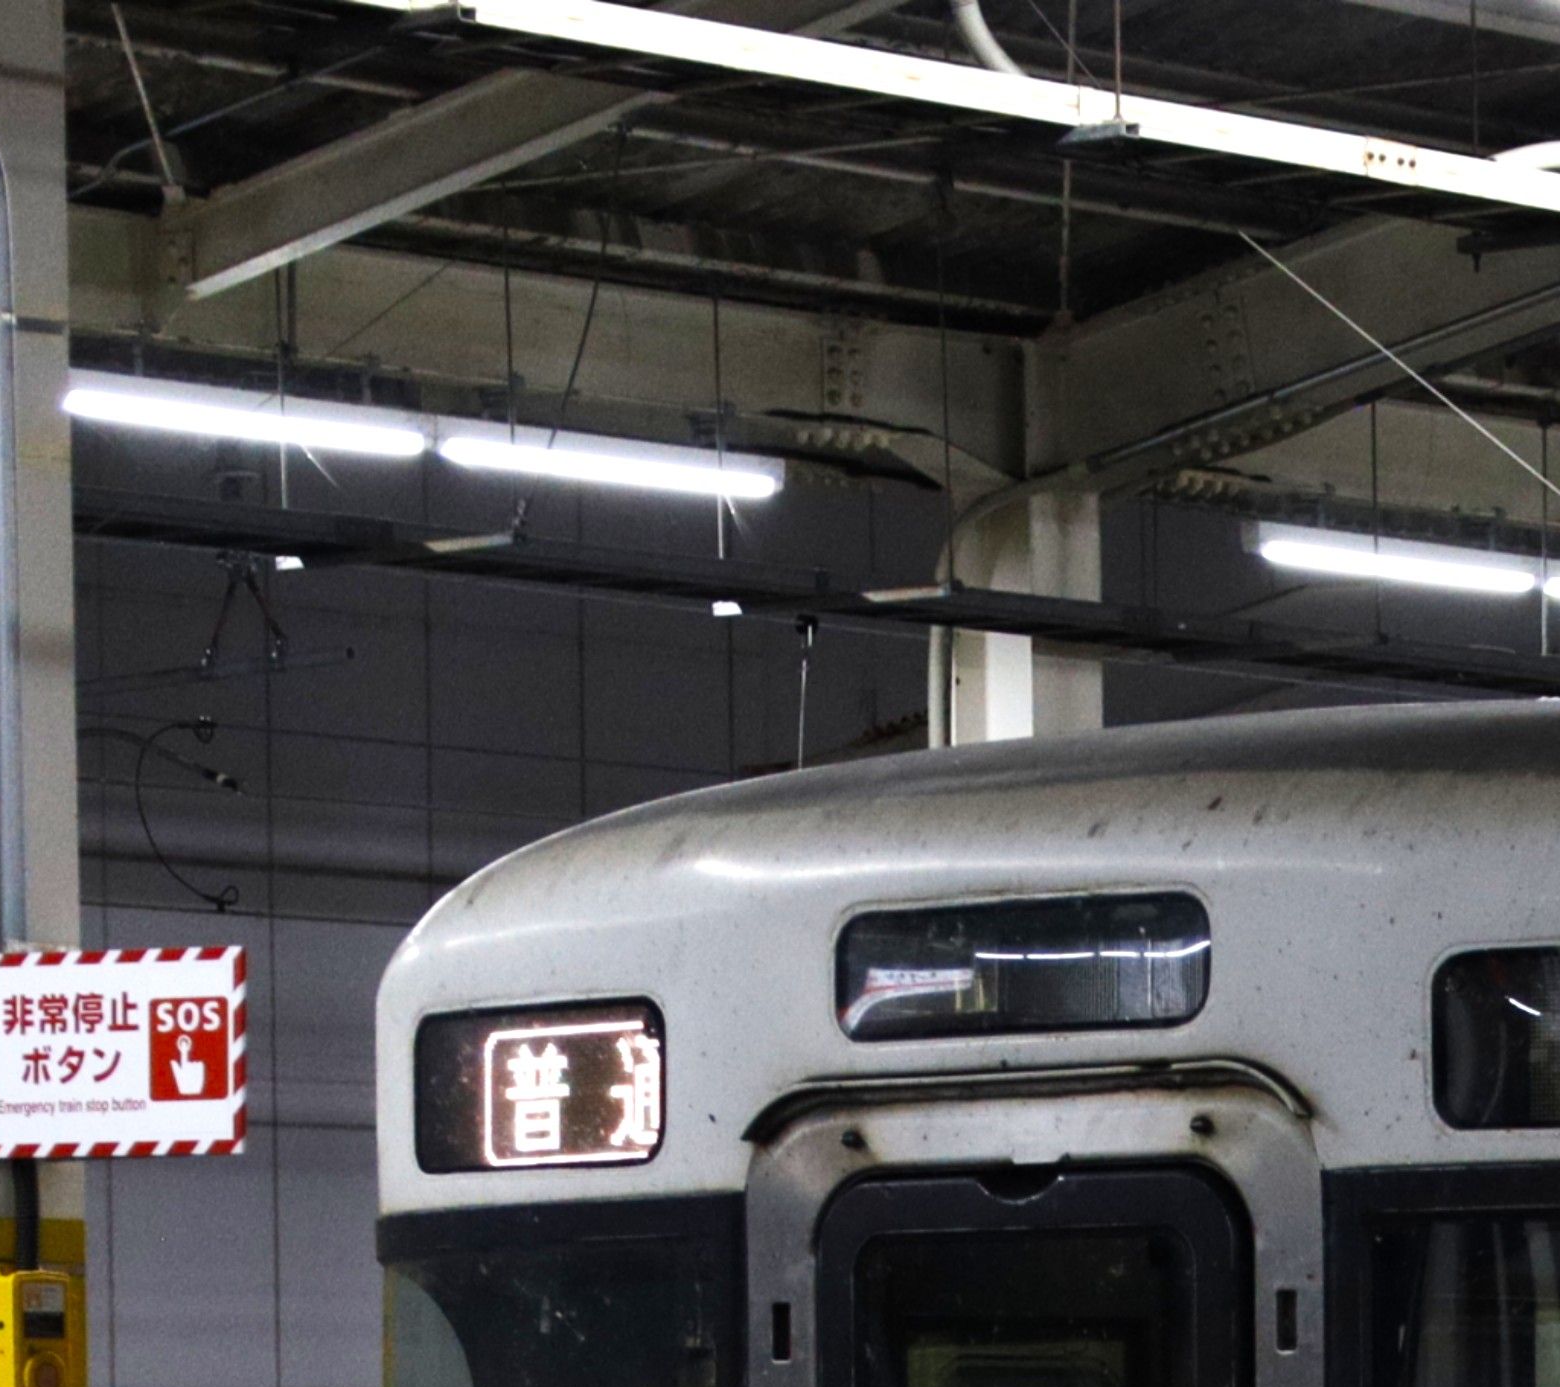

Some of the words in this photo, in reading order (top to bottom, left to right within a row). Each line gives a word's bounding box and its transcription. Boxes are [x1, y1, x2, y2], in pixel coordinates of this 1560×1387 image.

[2, 991, 140, 1035] 非常停止
[155, 1000, 221, 1033] SOS
[21, 1045, 121, 1085] ボタン
[58, 1098, 83, 1112] train
[85, 1098, 109, 1115] stop
[111, 1097, 147, 1112] button
